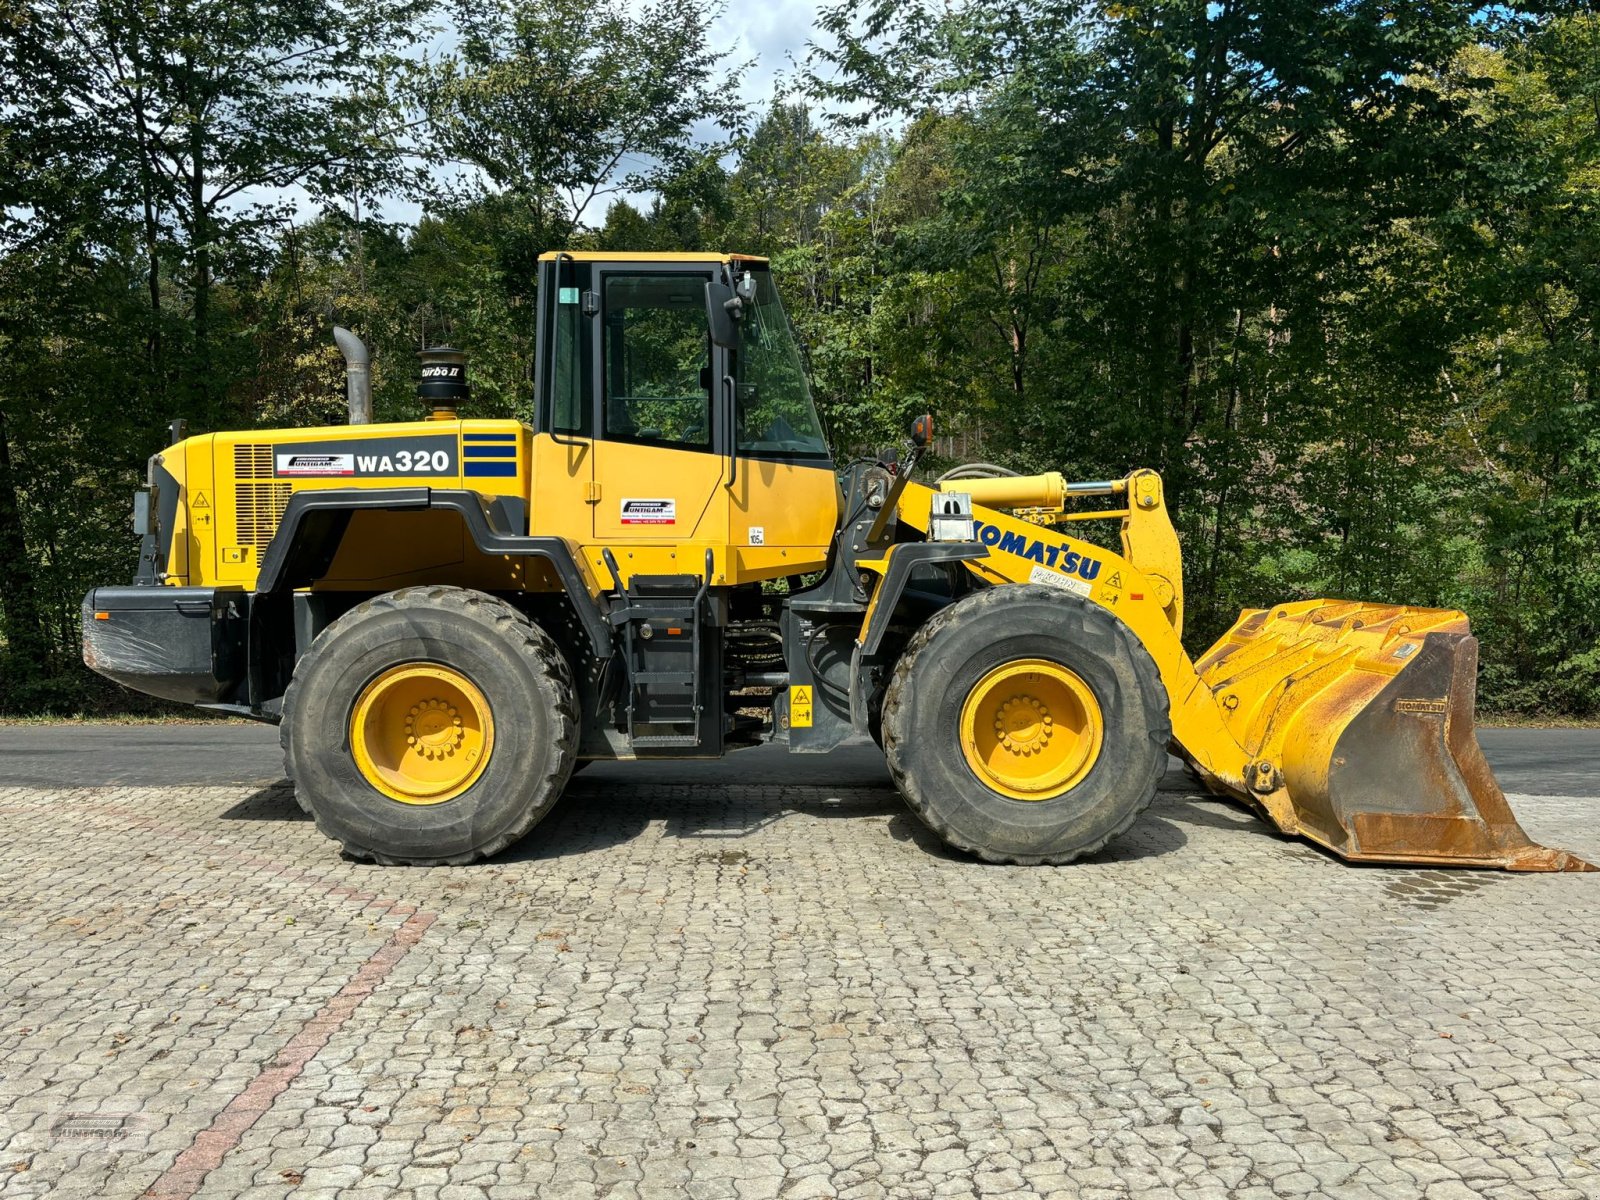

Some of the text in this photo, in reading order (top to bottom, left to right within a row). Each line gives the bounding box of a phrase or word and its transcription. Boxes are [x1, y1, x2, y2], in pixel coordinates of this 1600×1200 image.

[422, 366, 459, 377] turbo II
[356, 450, 449, 472] WA320
[1398, 702, 1445, 712] KOMATSU
